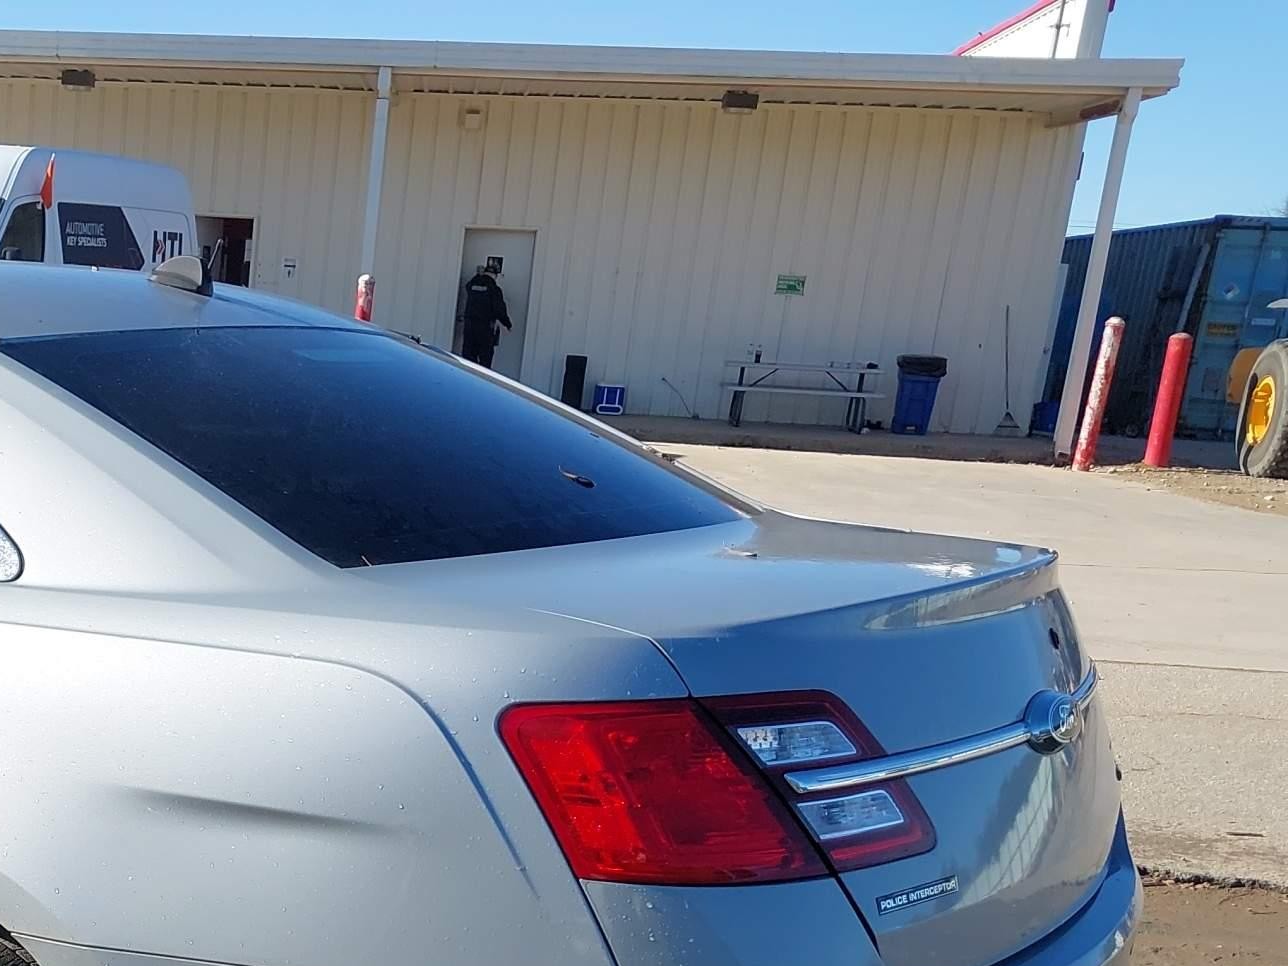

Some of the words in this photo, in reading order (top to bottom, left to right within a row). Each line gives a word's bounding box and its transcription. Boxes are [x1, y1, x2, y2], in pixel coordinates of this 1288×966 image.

[65, 221, 105, 236] AUTOMOTIVE
[66, 236, 78, 247] KEY
[77, 236, 108, 248] SPECIALISTS
[880, 895, 908, 911] POLICE
[908, 880, 957, 902] INTERCEPTOR
